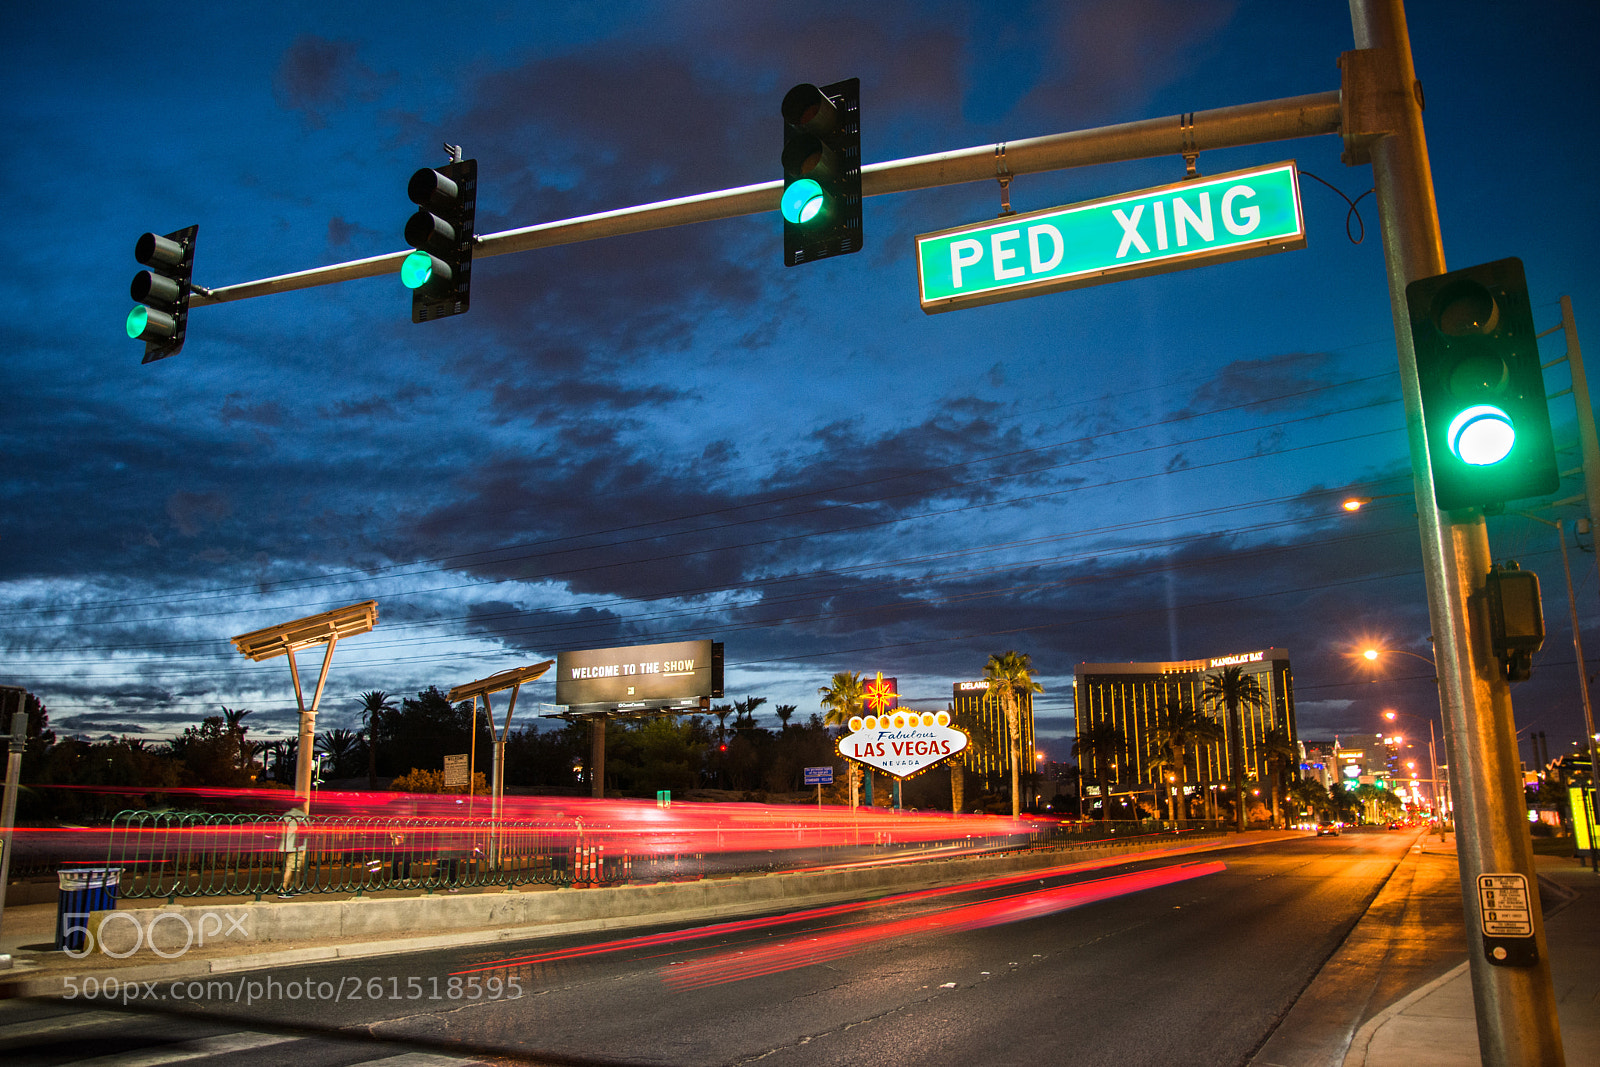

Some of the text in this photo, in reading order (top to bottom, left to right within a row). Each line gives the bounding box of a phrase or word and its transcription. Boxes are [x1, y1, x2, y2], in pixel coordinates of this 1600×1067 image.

[950, 185, 1261, 288] PED XING
[1210, 652, 1264, 667] MANDALAY BAY
[572, 659, 695, 679] WELCOME TO THE SHOW
[878, 730, 936, 741] Fabulous
[854, 740, 951, 757] LAS VEGAS
